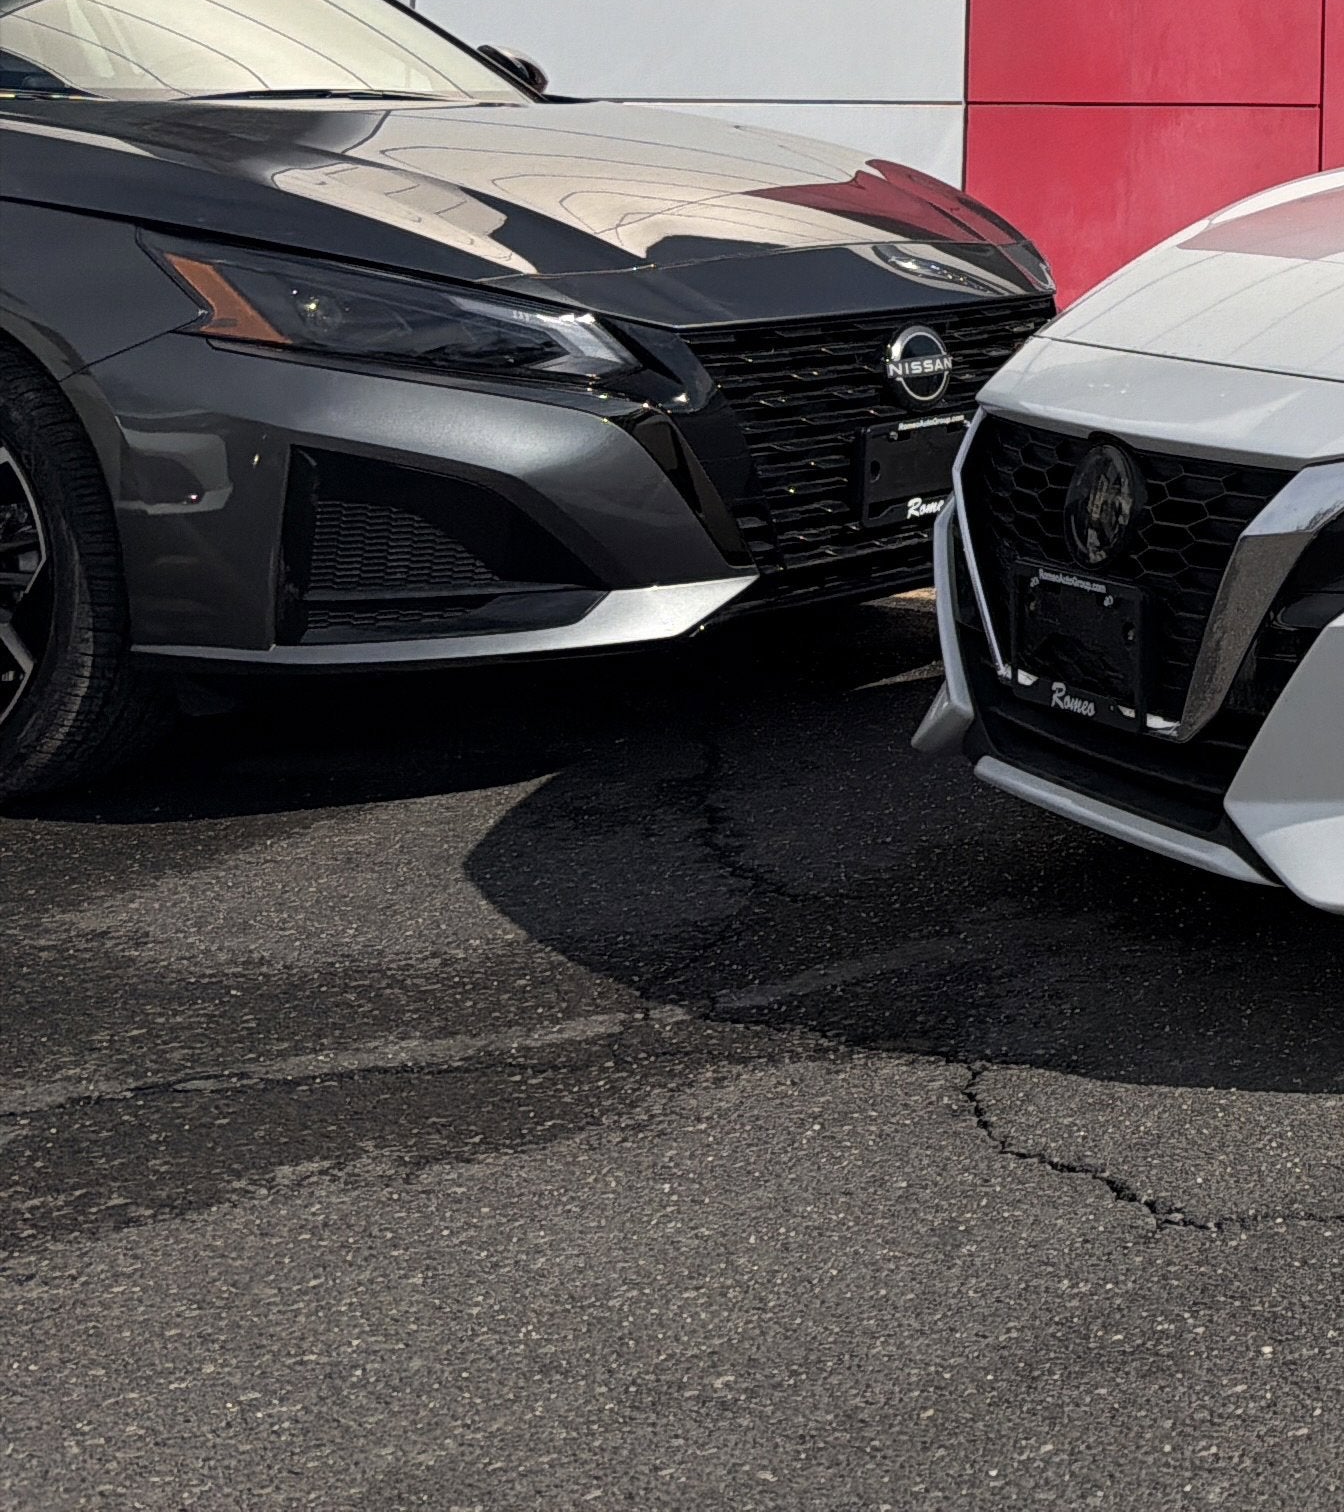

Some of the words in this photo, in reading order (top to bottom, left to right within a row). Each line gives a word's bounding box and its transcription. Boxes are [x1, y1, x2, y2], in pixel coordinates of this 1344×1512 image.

[888, 355, 953, 378] NISSAN
[907, 497, 946, 520] Rome
[1050, 681, 1096, 717] Romeo
